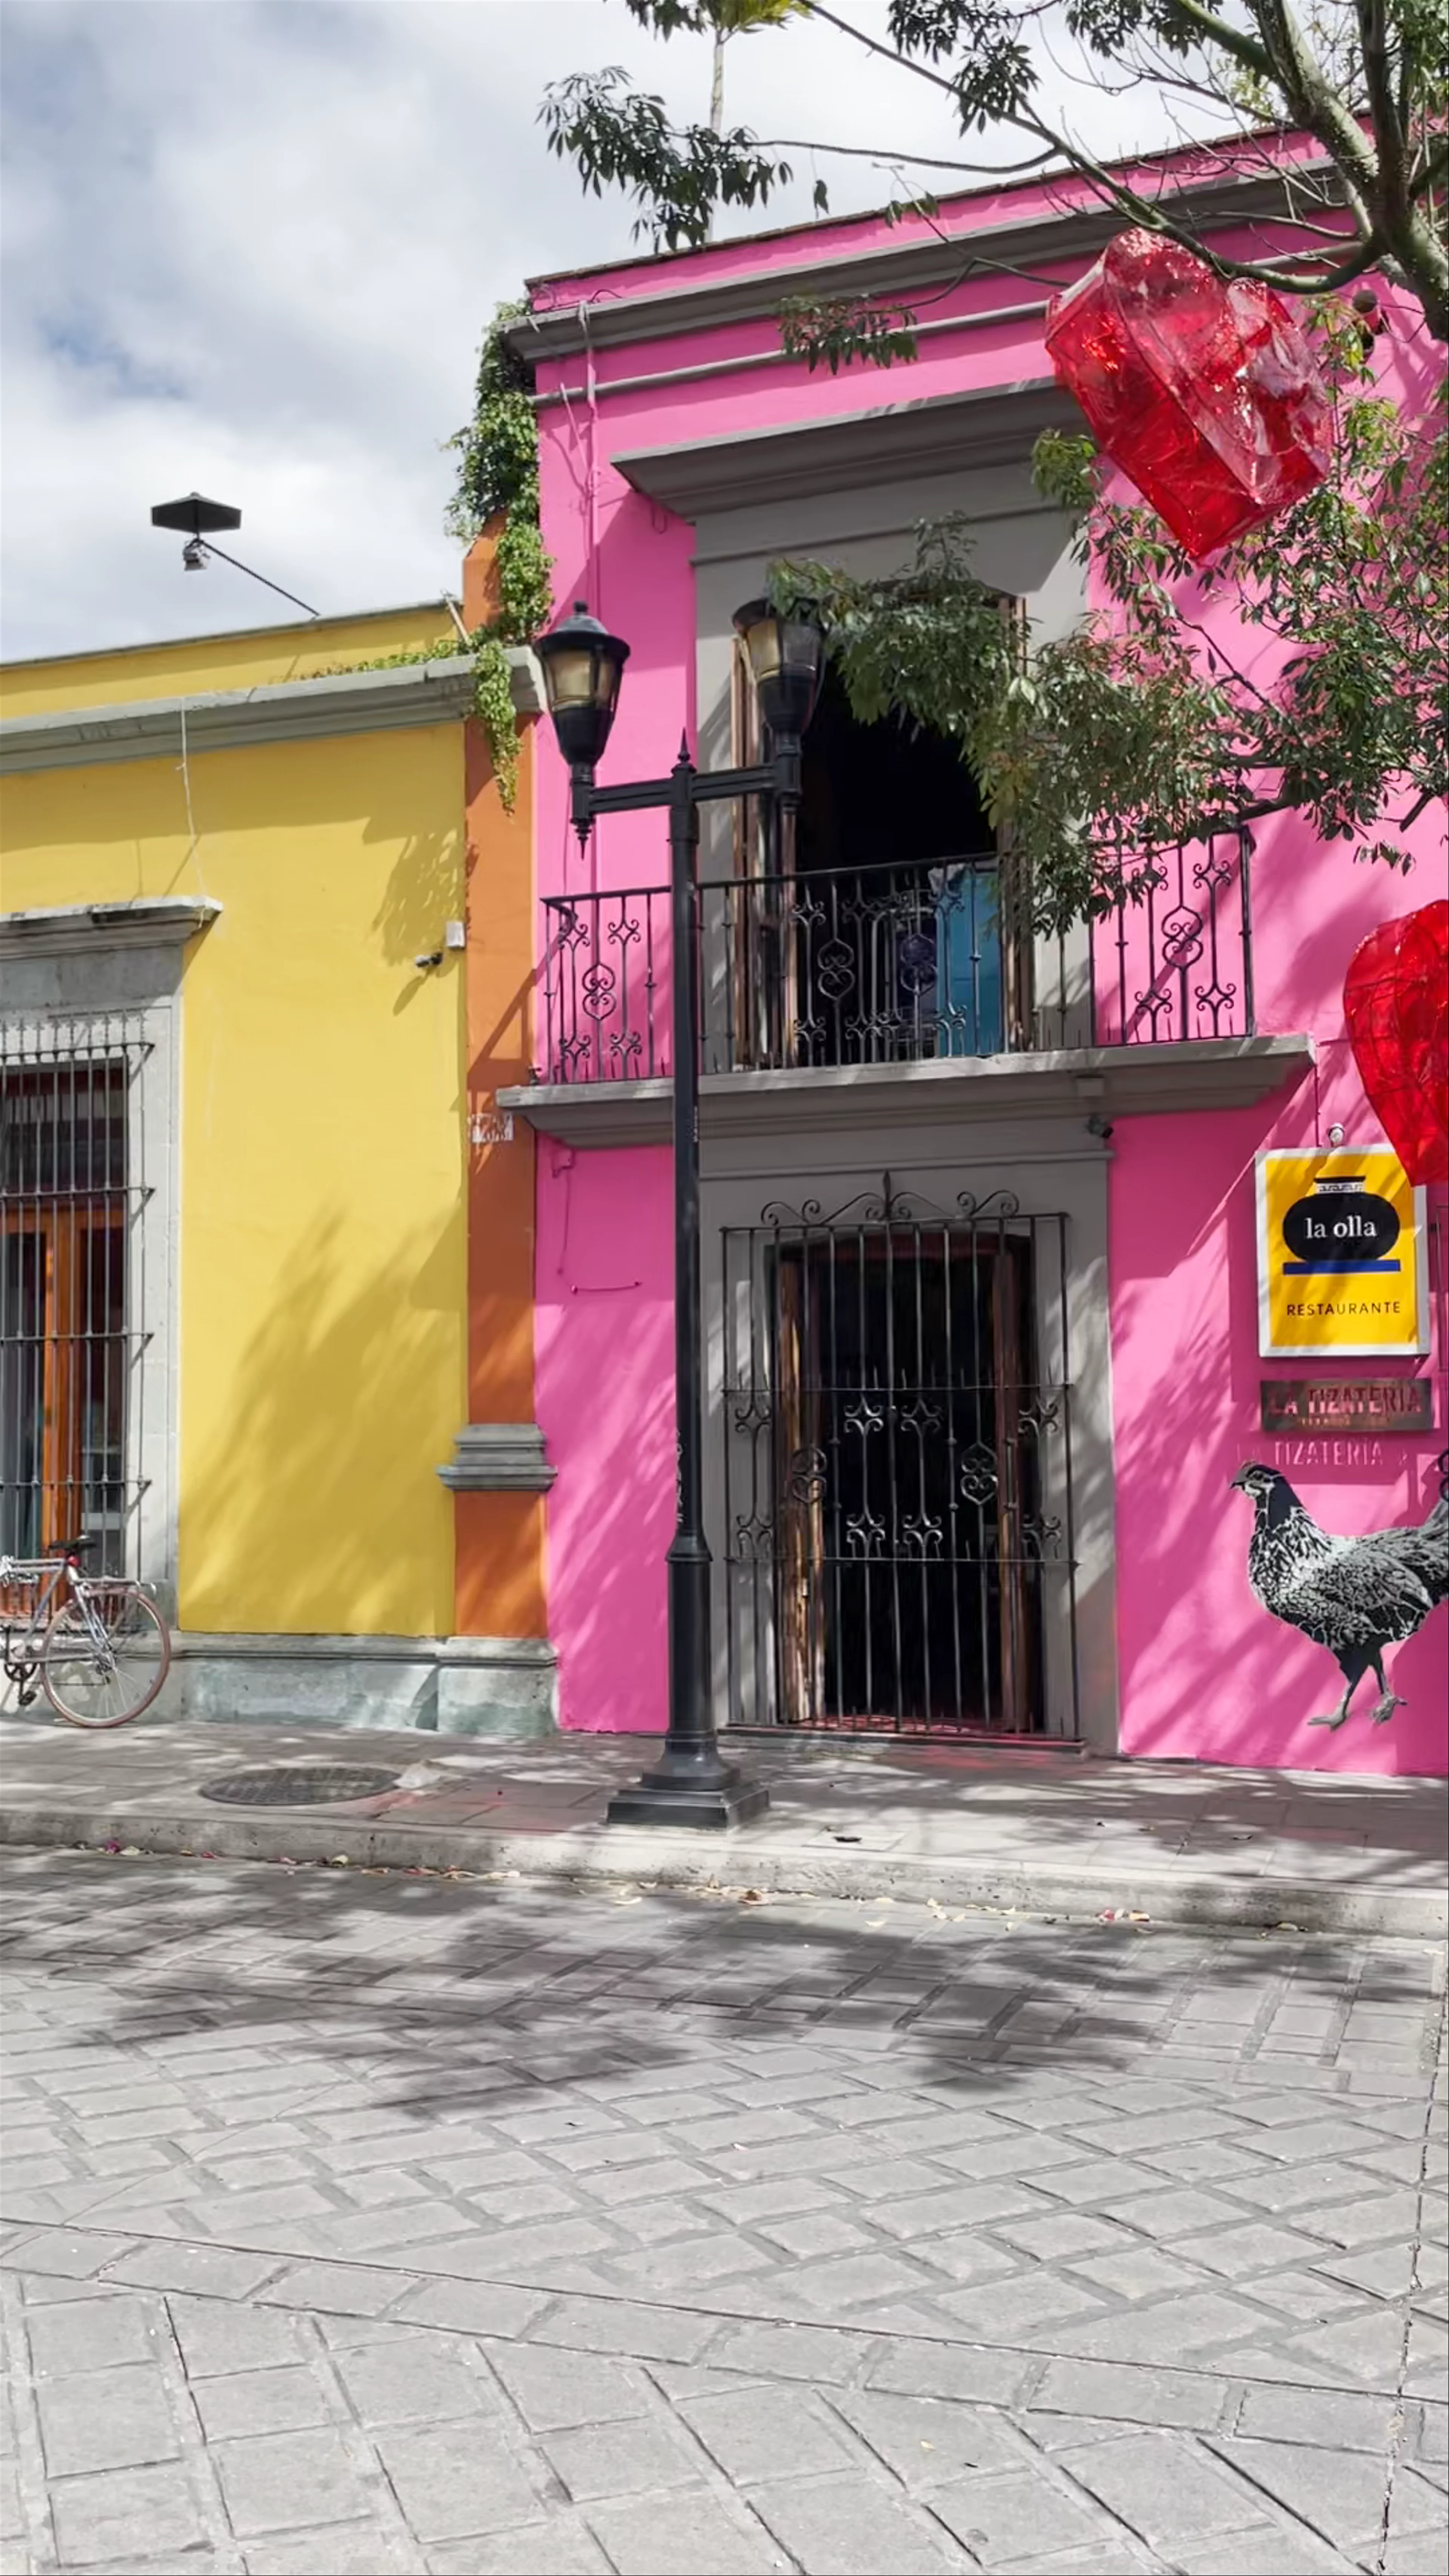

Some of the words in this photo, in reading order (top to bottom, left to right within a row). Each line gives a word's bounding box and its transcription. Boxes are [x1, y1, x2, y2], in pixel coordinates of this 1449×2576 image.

[1304, 1217, 1327, 1239] la
[1333, 1215, 1377, 1238] olla
[1287, 1301, 1401, 1316] RESTAURANTE
[1269, 1389, 1298, 1415] LA
[1308, 1386, 1421, 1414] TIZATERIA
